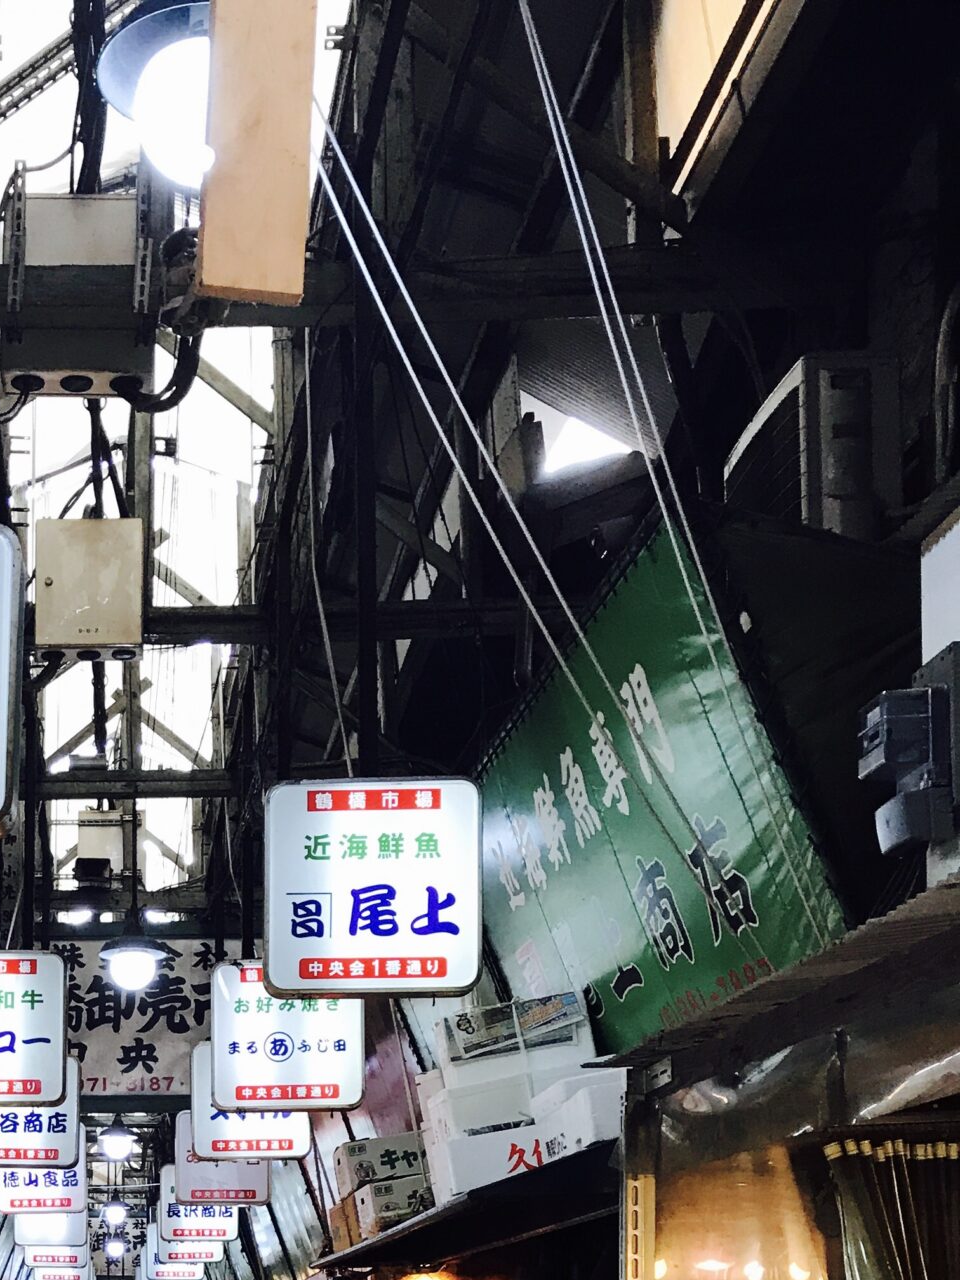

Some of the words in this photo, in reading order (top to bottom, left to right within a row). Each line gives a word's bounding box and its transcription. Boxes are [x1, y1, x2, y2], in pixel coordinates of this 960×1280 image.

[315, 791, 433, 810] 鶴橋市場
[304, 832, 441, 860] 近海鮮魚
[349, 884, 460, 937] 尾上
[308, 958, 439, 976] 中央会1番通り
[241, 1086, 334, 1099] 中央会1番通り
